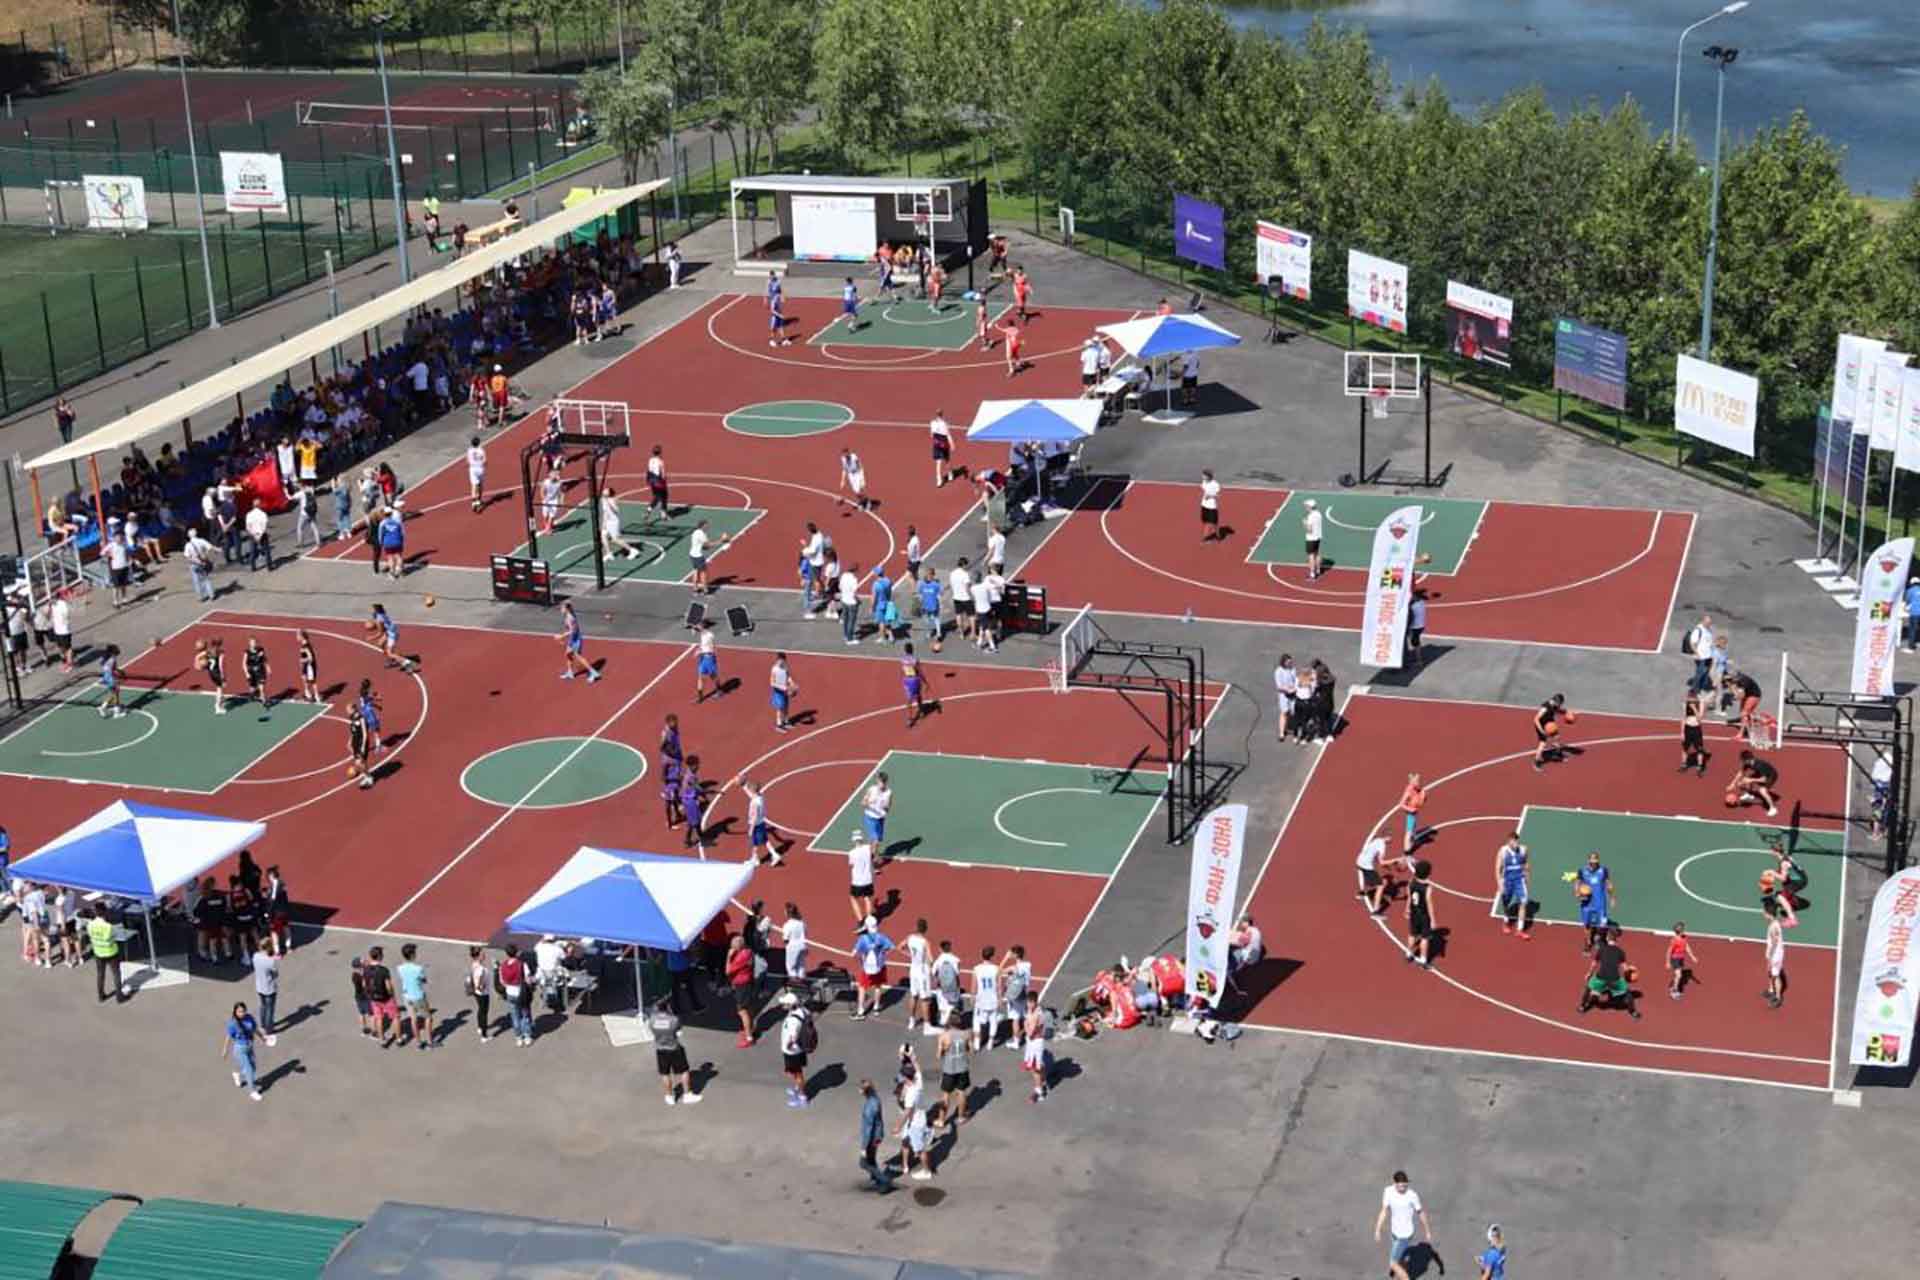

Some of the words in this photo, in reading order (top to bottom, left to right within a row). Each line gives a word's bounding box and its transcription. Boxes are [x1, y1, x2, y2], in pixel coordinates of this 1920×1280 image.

[1376, 592, 1397, 663] ФАН-ЗОНА
[1206, 816, 1233, 905] ФАН-ЗОНА
[1887, 877, 1920, 962] ФАН-ЗОНА
